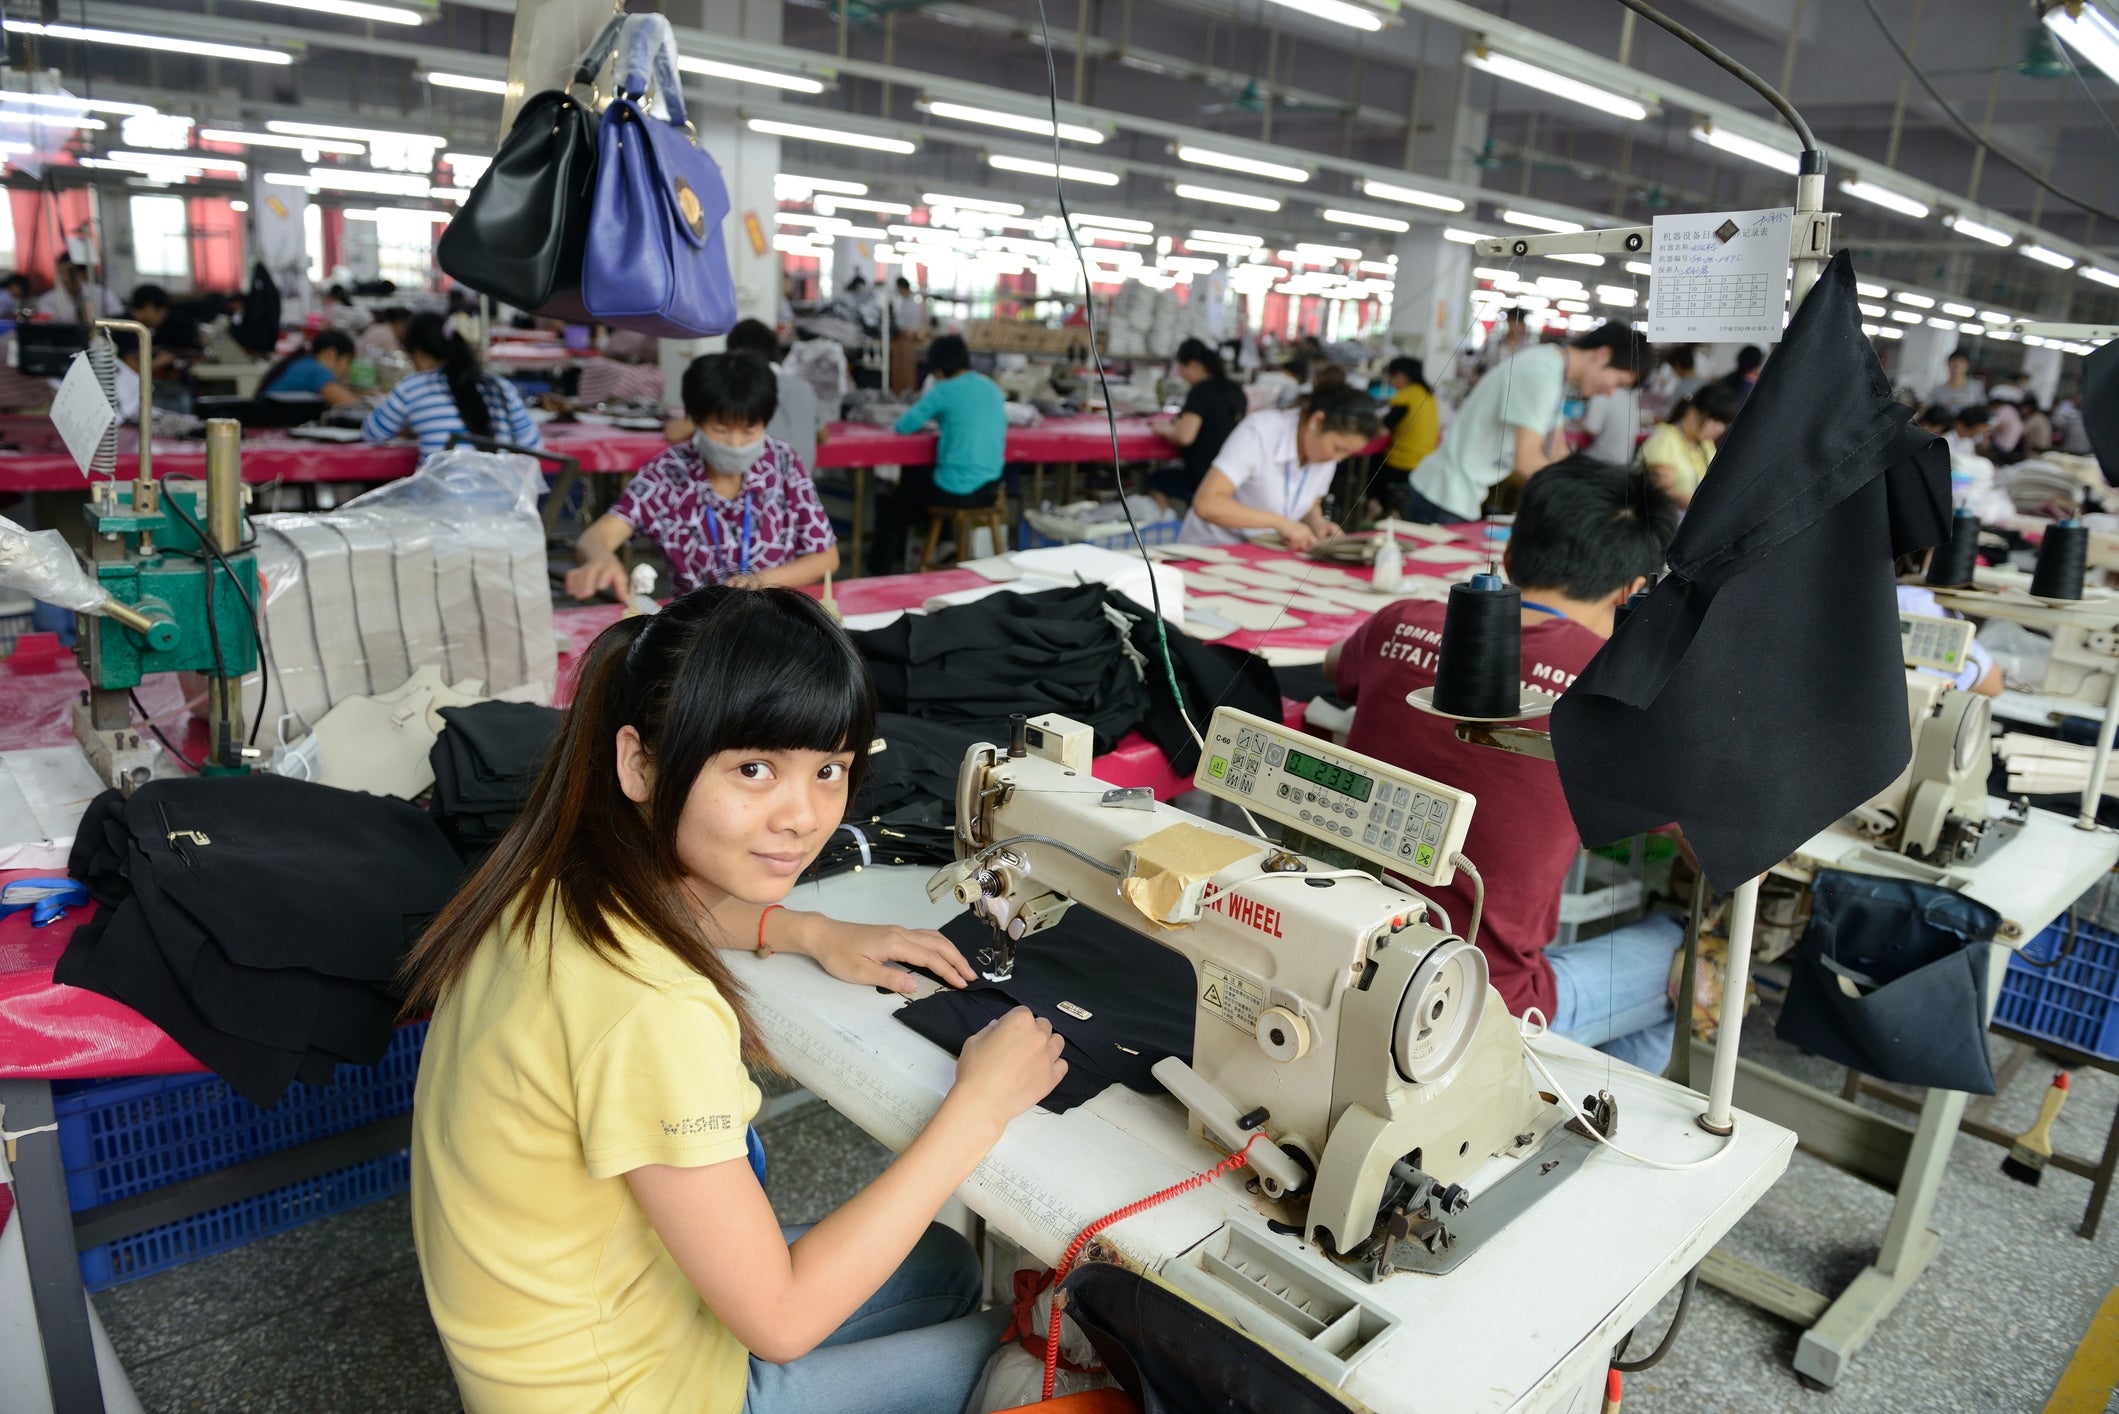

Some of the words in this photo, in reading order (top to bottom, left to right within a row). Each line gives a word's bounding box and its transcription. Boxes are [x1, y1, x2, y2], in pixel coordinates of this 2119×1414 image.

[1395, 623, 1441, 647] COMM
[1216, 734, 1231, 745] C-60
[1229, 892, 1283, 939] WHEEL
[1044, 1211, 1058, 1224] 25
